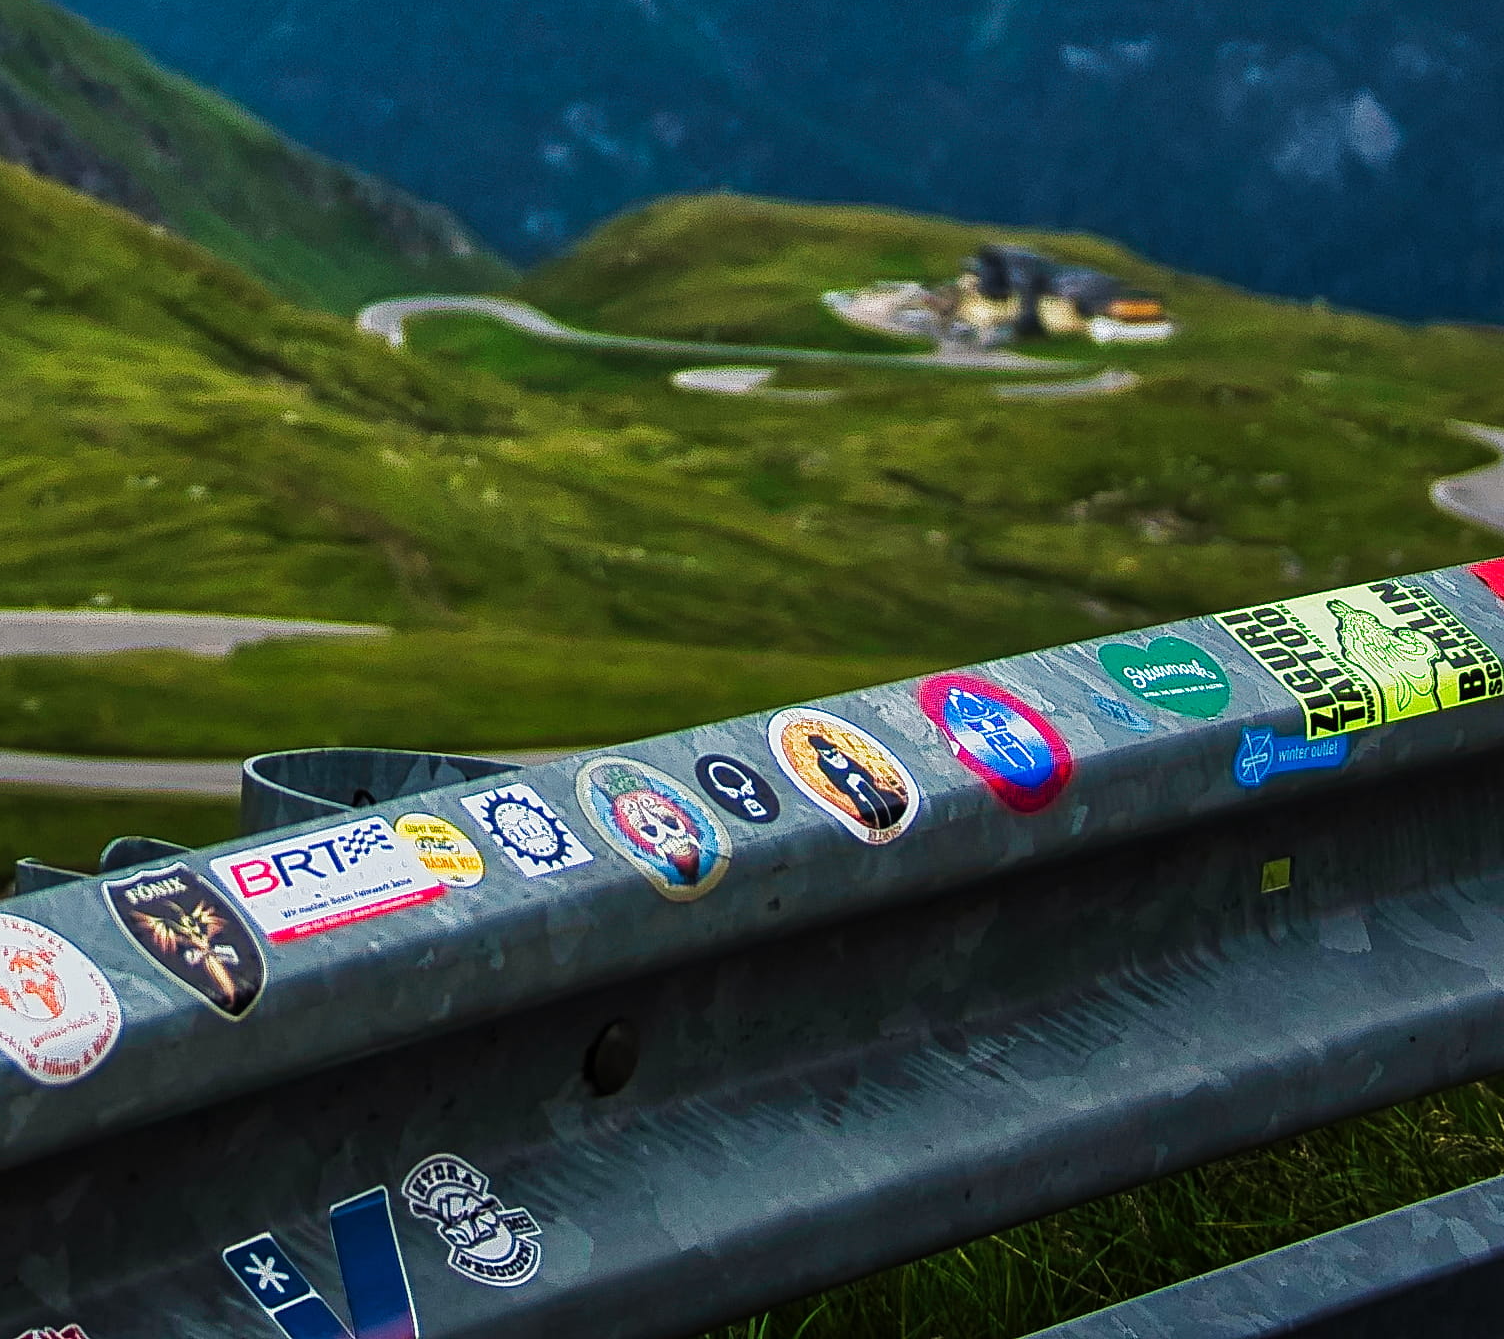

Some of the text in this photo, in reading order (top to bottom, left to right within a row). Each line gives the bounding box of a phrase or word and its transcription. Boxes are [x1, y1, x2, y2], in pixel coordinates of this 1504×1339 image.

[1255, 607, 1368, 729] TATTOO
[1368, 583, 1487, 701] BERLIN
[1222, 613, 1339, 737] ZIGURI
[1278, 740, 1338, 763] winter outlet
[230, 839, 345, 899] BRT
[412, 1164, 477, 1197] HYDRA
[504, 1216, 528, 1231] MC
